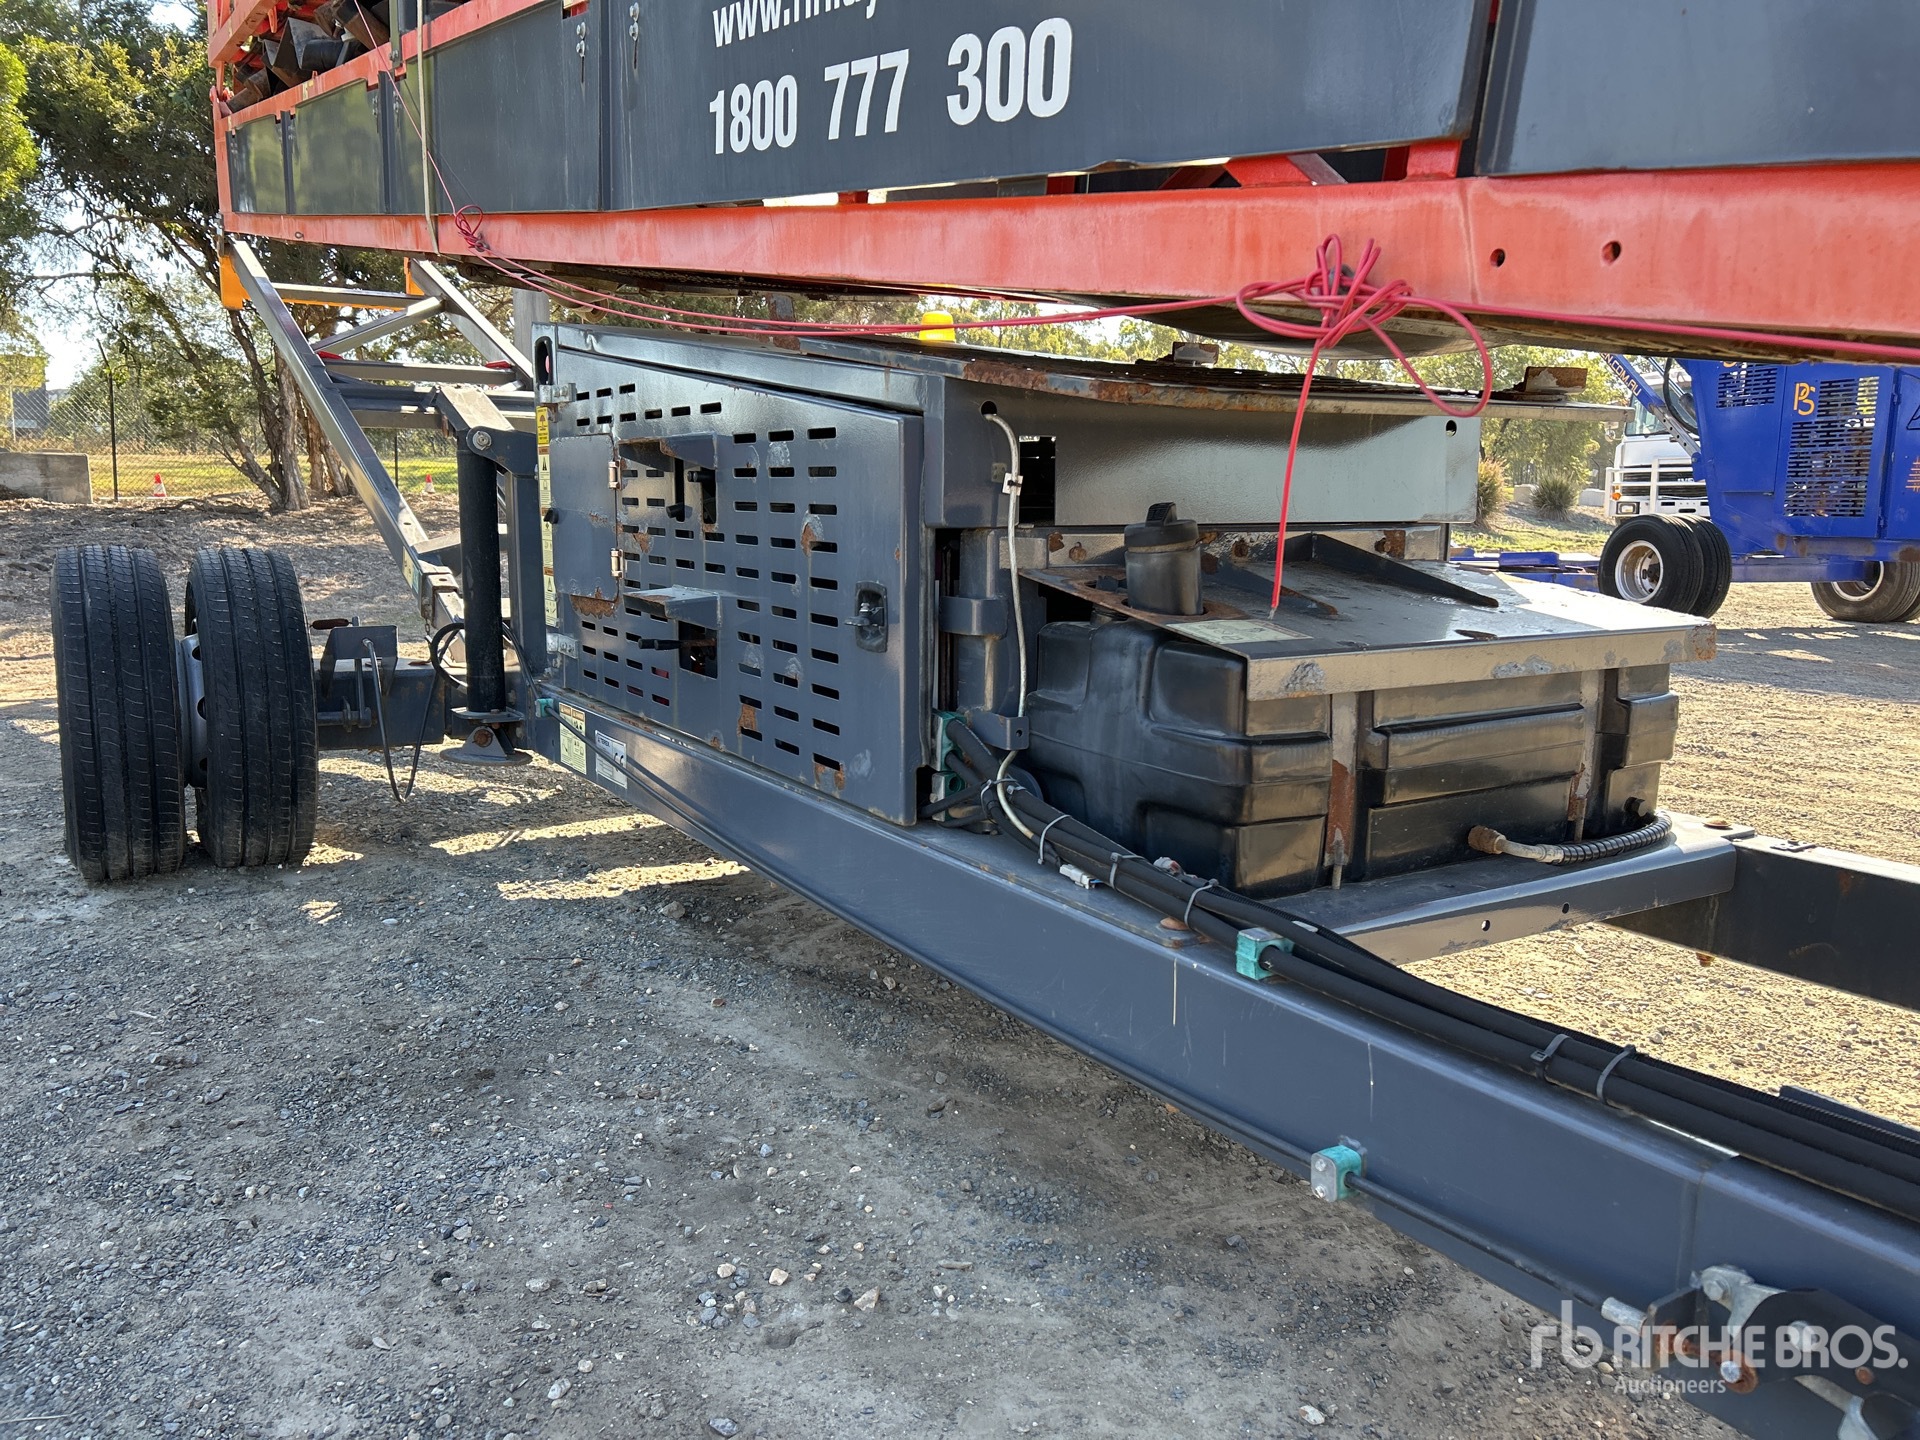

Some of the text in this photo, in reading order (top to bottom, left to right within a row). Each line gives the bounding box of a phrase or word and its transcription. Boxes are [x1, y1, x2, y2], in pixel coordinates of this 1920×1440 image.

[709, 74, 798, 154] 1800
[824, 48, 910, 140] 777
[946, 17, 1073, 126] 300
